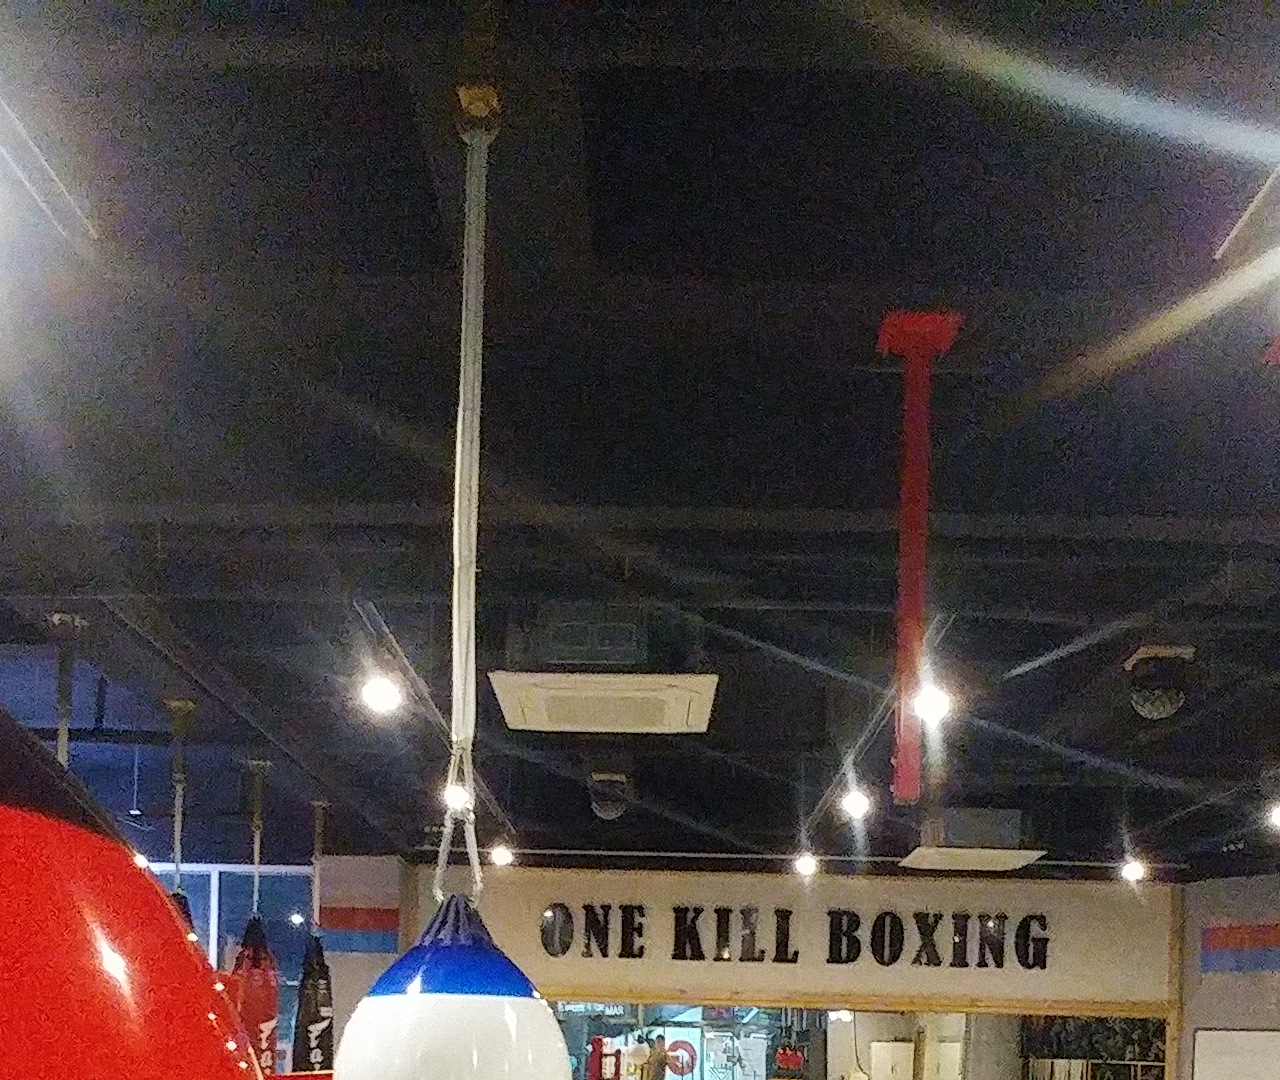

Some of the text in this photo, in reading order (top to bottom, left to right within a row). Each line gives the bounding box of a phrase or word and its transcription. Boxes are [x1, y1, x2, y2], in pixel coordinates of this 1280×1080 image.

[540, 902, 1050, 970] ONE KILL BOXING
